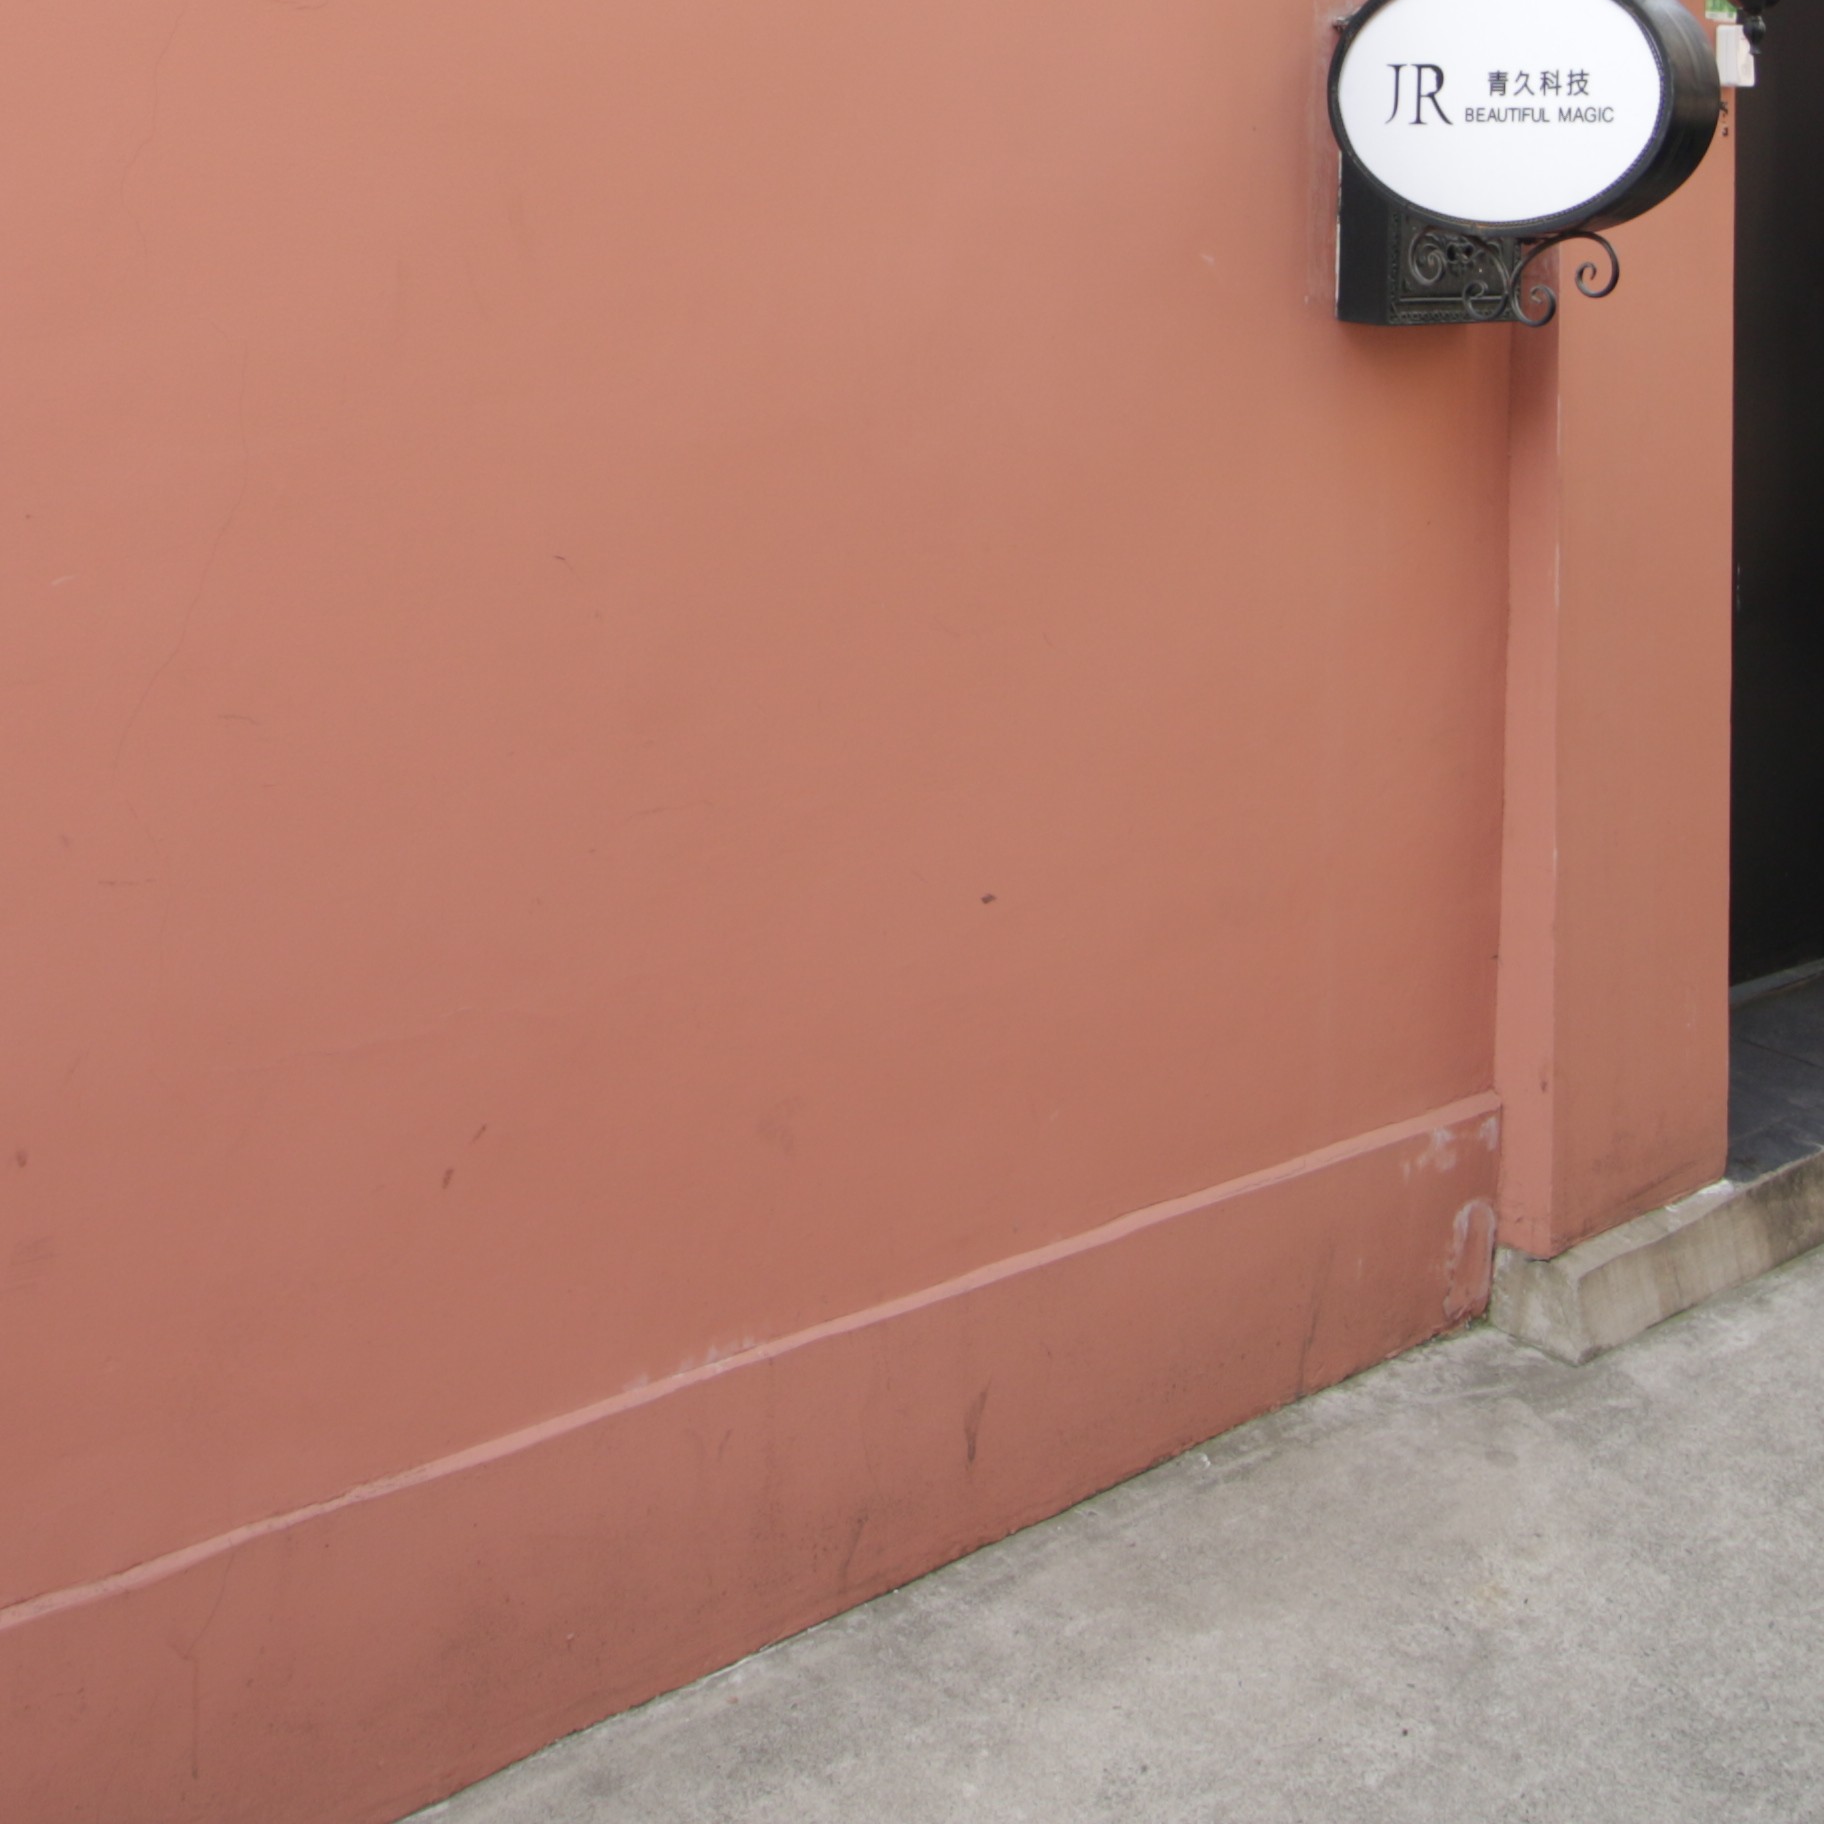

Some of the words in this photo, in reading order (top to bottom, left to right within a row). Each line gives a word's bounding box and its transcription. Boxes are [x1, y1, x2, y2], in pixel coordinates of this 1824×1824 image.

[1384, 63, 1453, 126] JR
[1488, 68, 1590, 97] 青久科技
[1464, 107, 1550, 124] BEAUTIFUL
[1558, 107, 1615, 124] MAGIC
